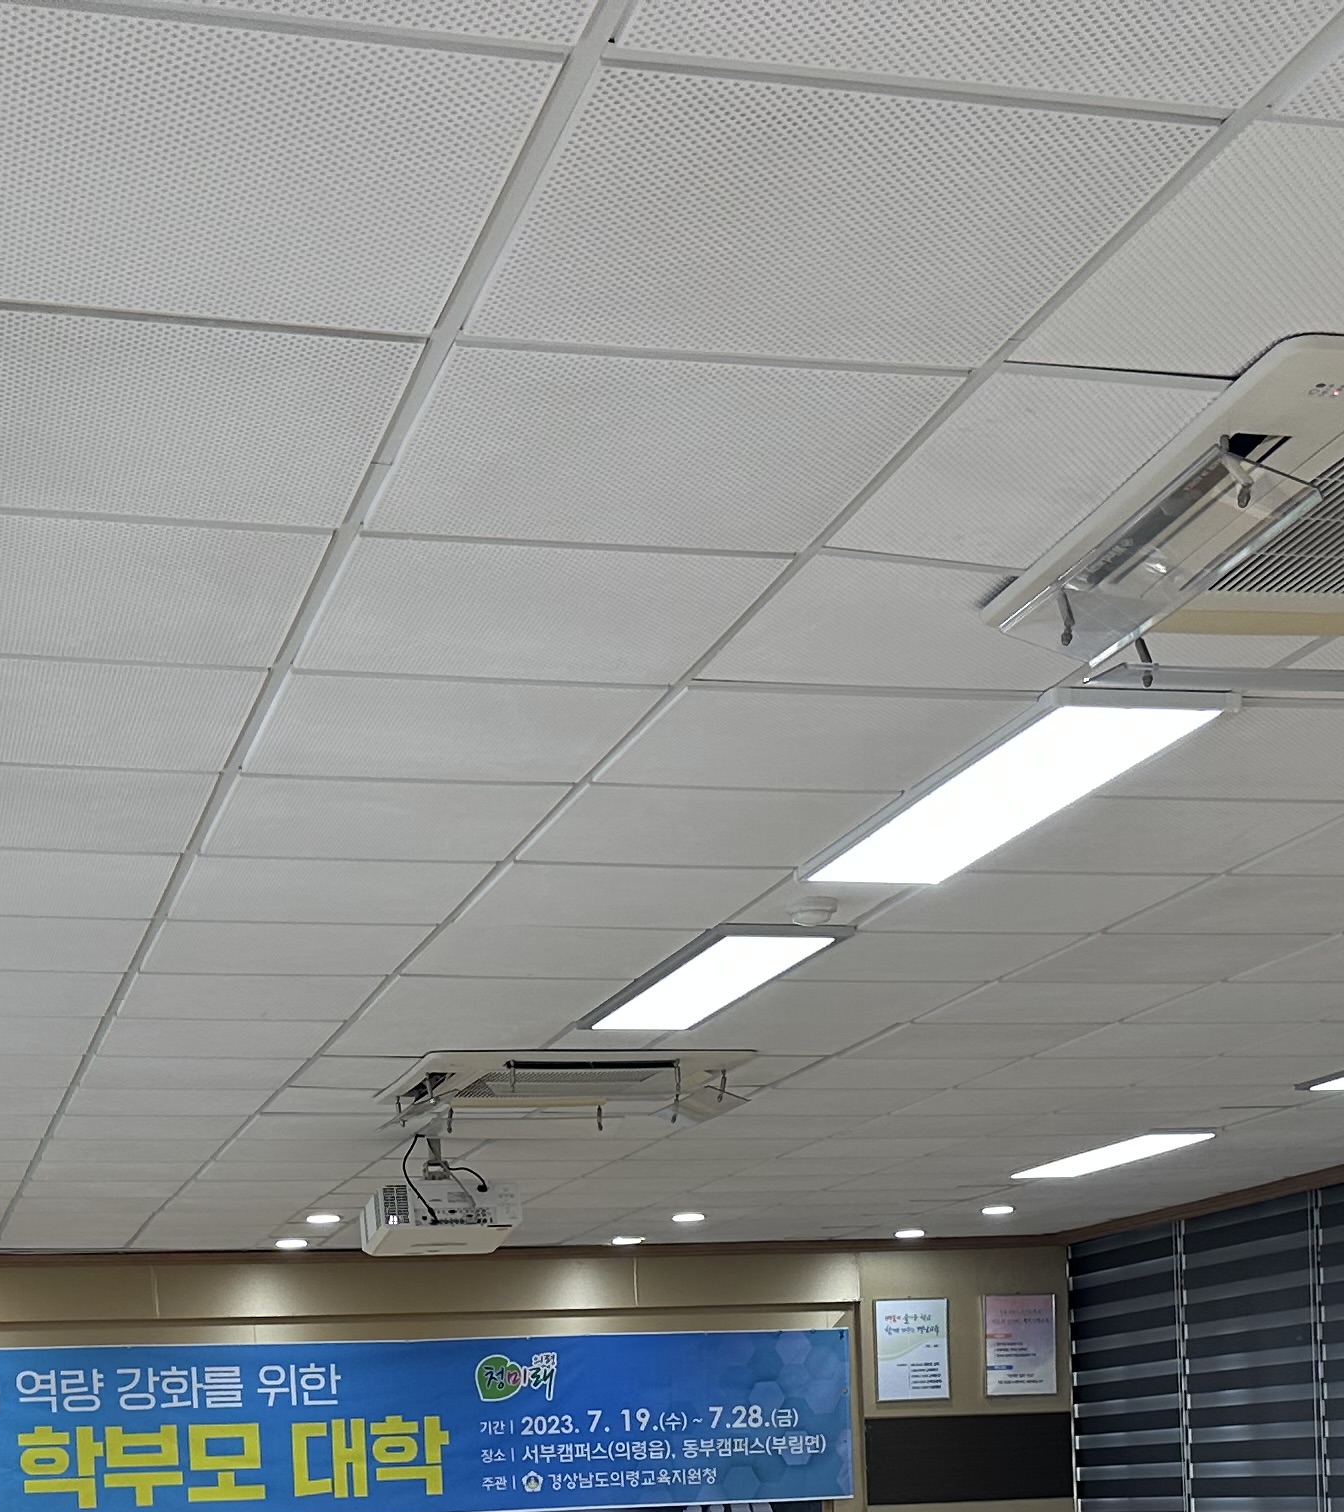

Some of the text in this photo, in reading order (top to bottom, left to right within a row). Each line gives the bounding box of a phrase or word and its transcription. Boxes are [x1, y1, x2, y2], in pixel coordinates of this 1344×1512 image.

[532, 1353, 556, 1369] 의령
[16, 1368, 104, 1413] 역량
[116, 1366, 244, 1411] 강화를
[257, 1362, 342, 1407] 위한
[483, 1366, 555, 1400] 청미래
[480, 1420, 506, 1436] 기간
[521, 1414, 580, 1436] 2023.
[587, 1410, 610, 1433] 7.
[18, 1423, 266, 1509] 학부모
[291, 1415, 449, 1498] 대학
[481, 1449, 506, 1464] 장소
[522, 1439, 676, 1464] 서부캠퍼스(의령읍),
[682, 1434, 827, 1460] 동부캠퍼스(부림면)
[481, 1476, 508, 1491] 주관
[548, 1467, 717, 1491] 경상남도의령교육지원청
